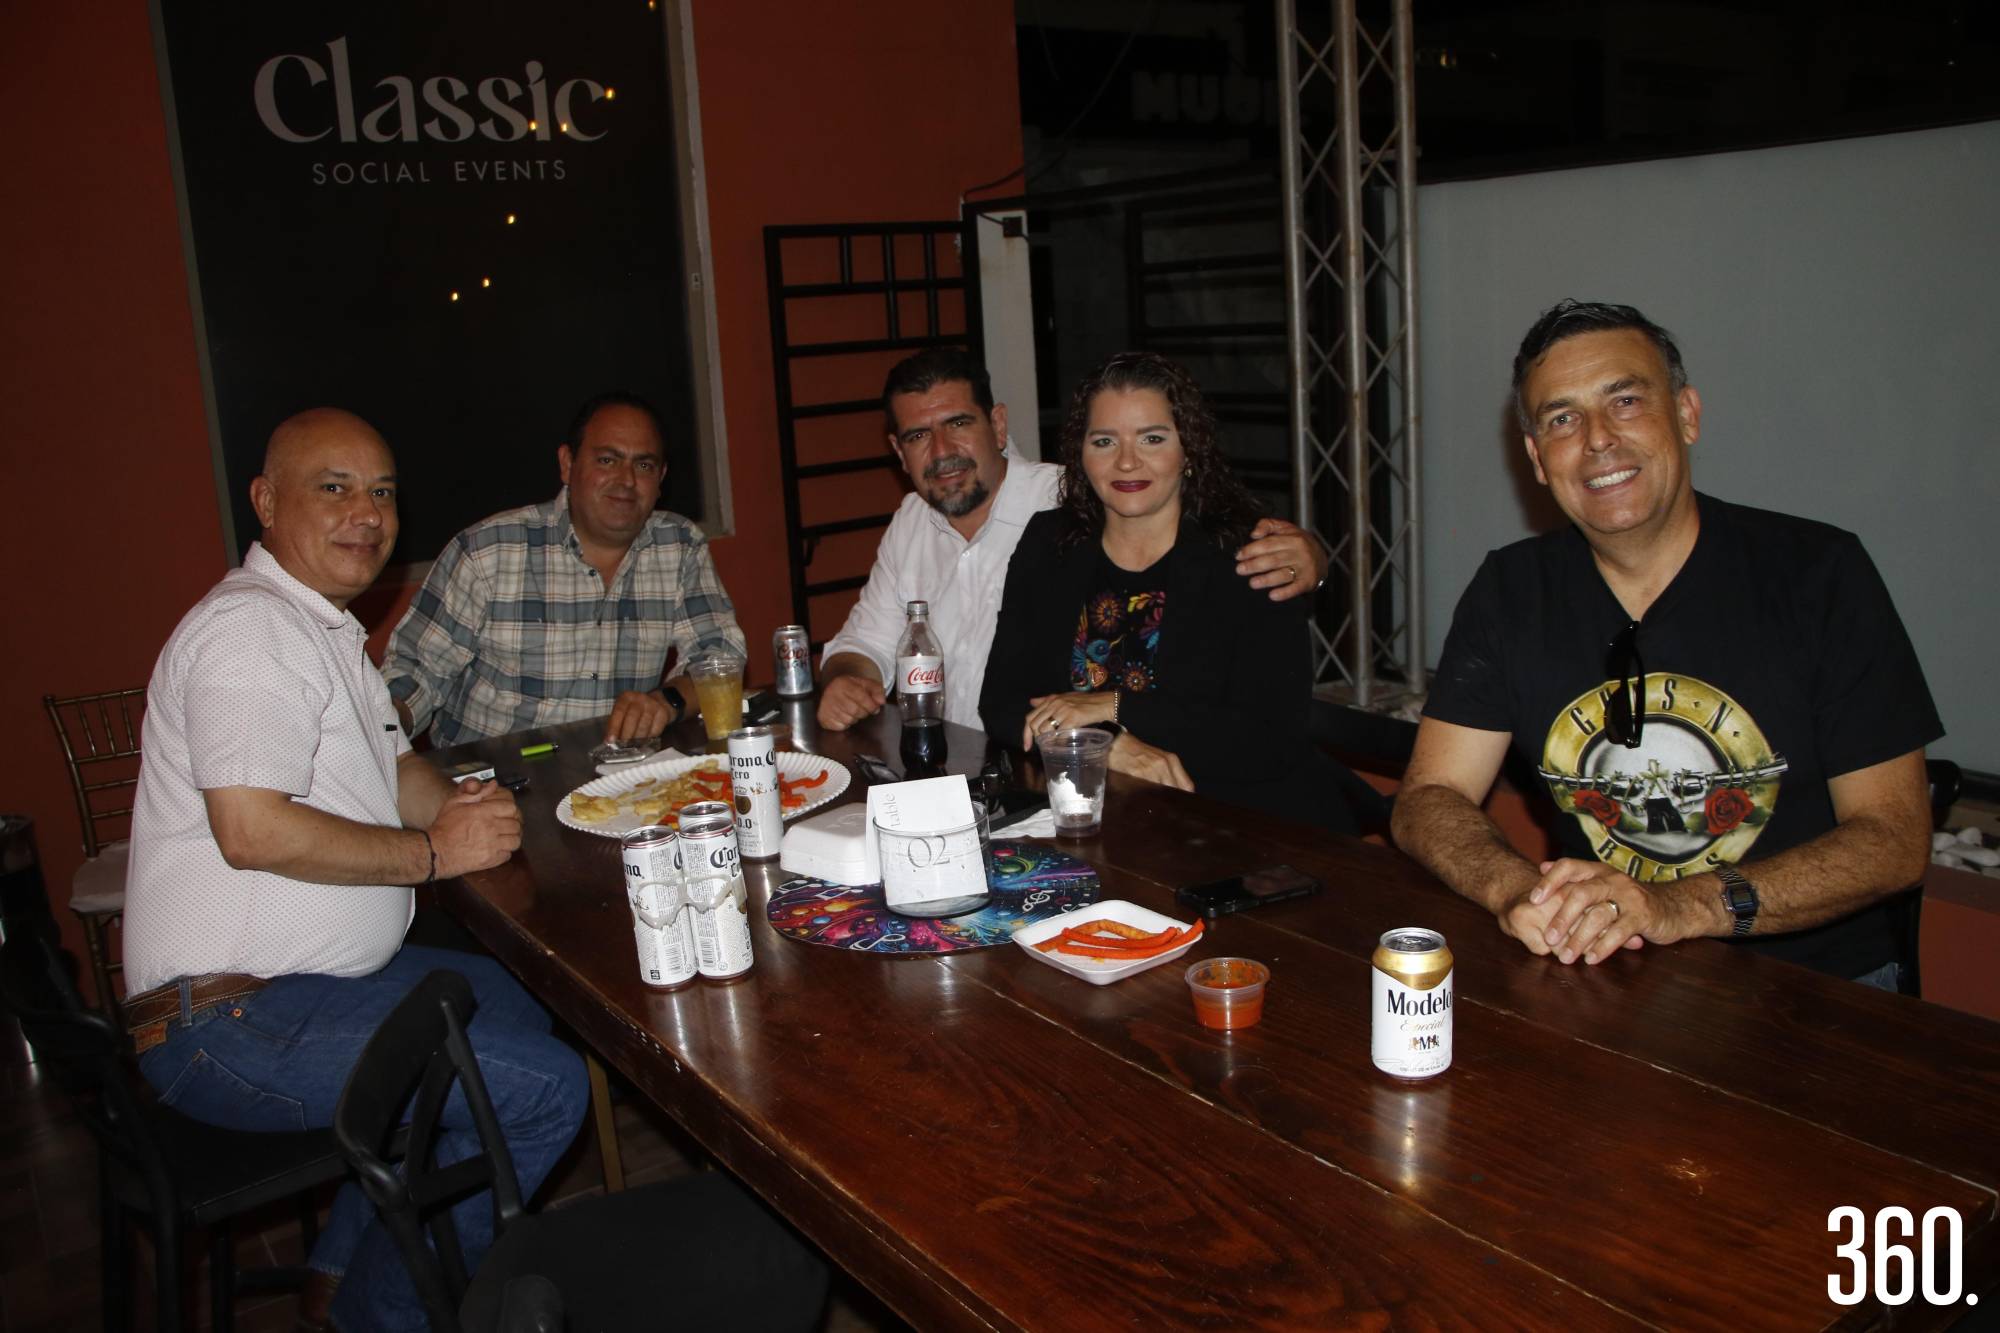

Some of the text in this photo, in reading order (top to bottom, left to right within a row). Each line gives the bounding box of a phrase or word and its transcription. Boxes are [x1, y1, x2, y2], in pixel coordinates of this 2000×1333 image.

[254, 34, 609, 143] Classic
[312, 158, 566, 185] SOCIAL EVENTS
[907, 835, 951, 868] 02
[1387, 988, 1452, 1017] Modelo
